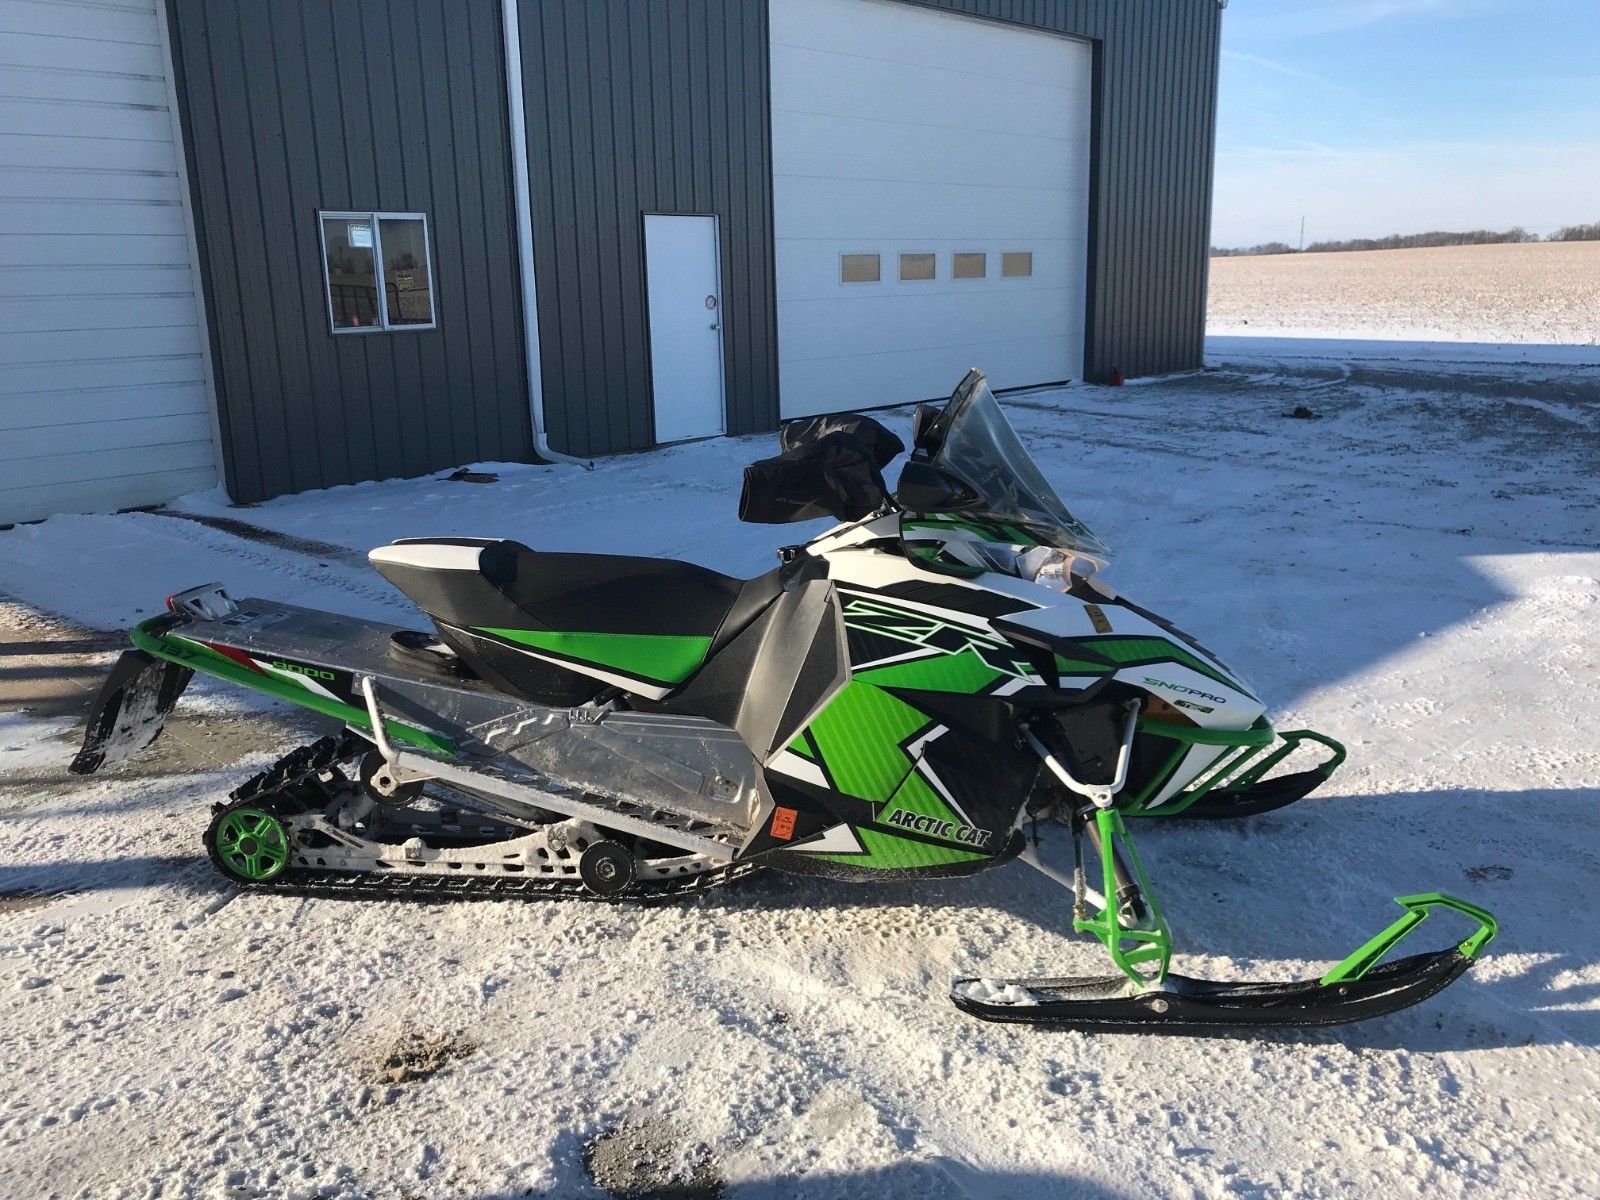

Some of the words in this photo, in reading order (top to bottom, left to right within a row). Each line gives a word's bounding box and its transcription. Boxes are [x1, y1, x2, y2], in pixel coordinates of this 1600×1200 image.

[272, 660, 336, 681] 9000
[887, 808, 955, 839] ARCTIC
[955, 824, 993, 847] CAT
